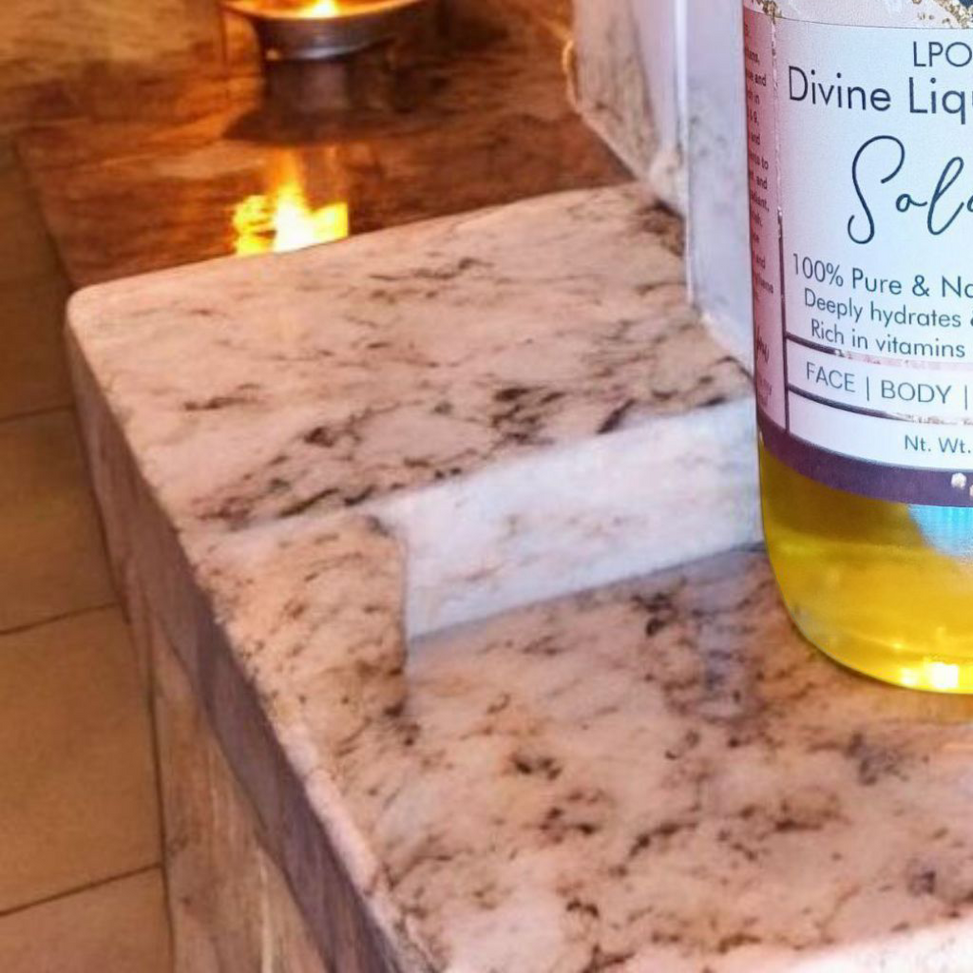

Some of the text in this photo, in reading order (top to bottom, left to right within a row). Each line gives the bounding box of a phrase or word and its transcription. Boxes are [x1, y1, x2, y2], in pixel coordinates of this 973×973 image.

[788, 65, 891, 112] Divine
[792, 253, 844, 288] 100%
[852, 268, 901, 296] Pure
[911, 275, 931, 297] &
[804, 289, 863, 323] Deeply
[870, 298, 961, 329] hydrates
[811, 319, 844, 345] Rich
[852, 330, 868, 351] in
[875, 333, 965, 358] vitamins
[805, 362, 856, 393] FACE
[881, 380, 952, 405] BODY
[905, 435, 931, 452] Nt.
[938, 437, 972, 454] Wt.
